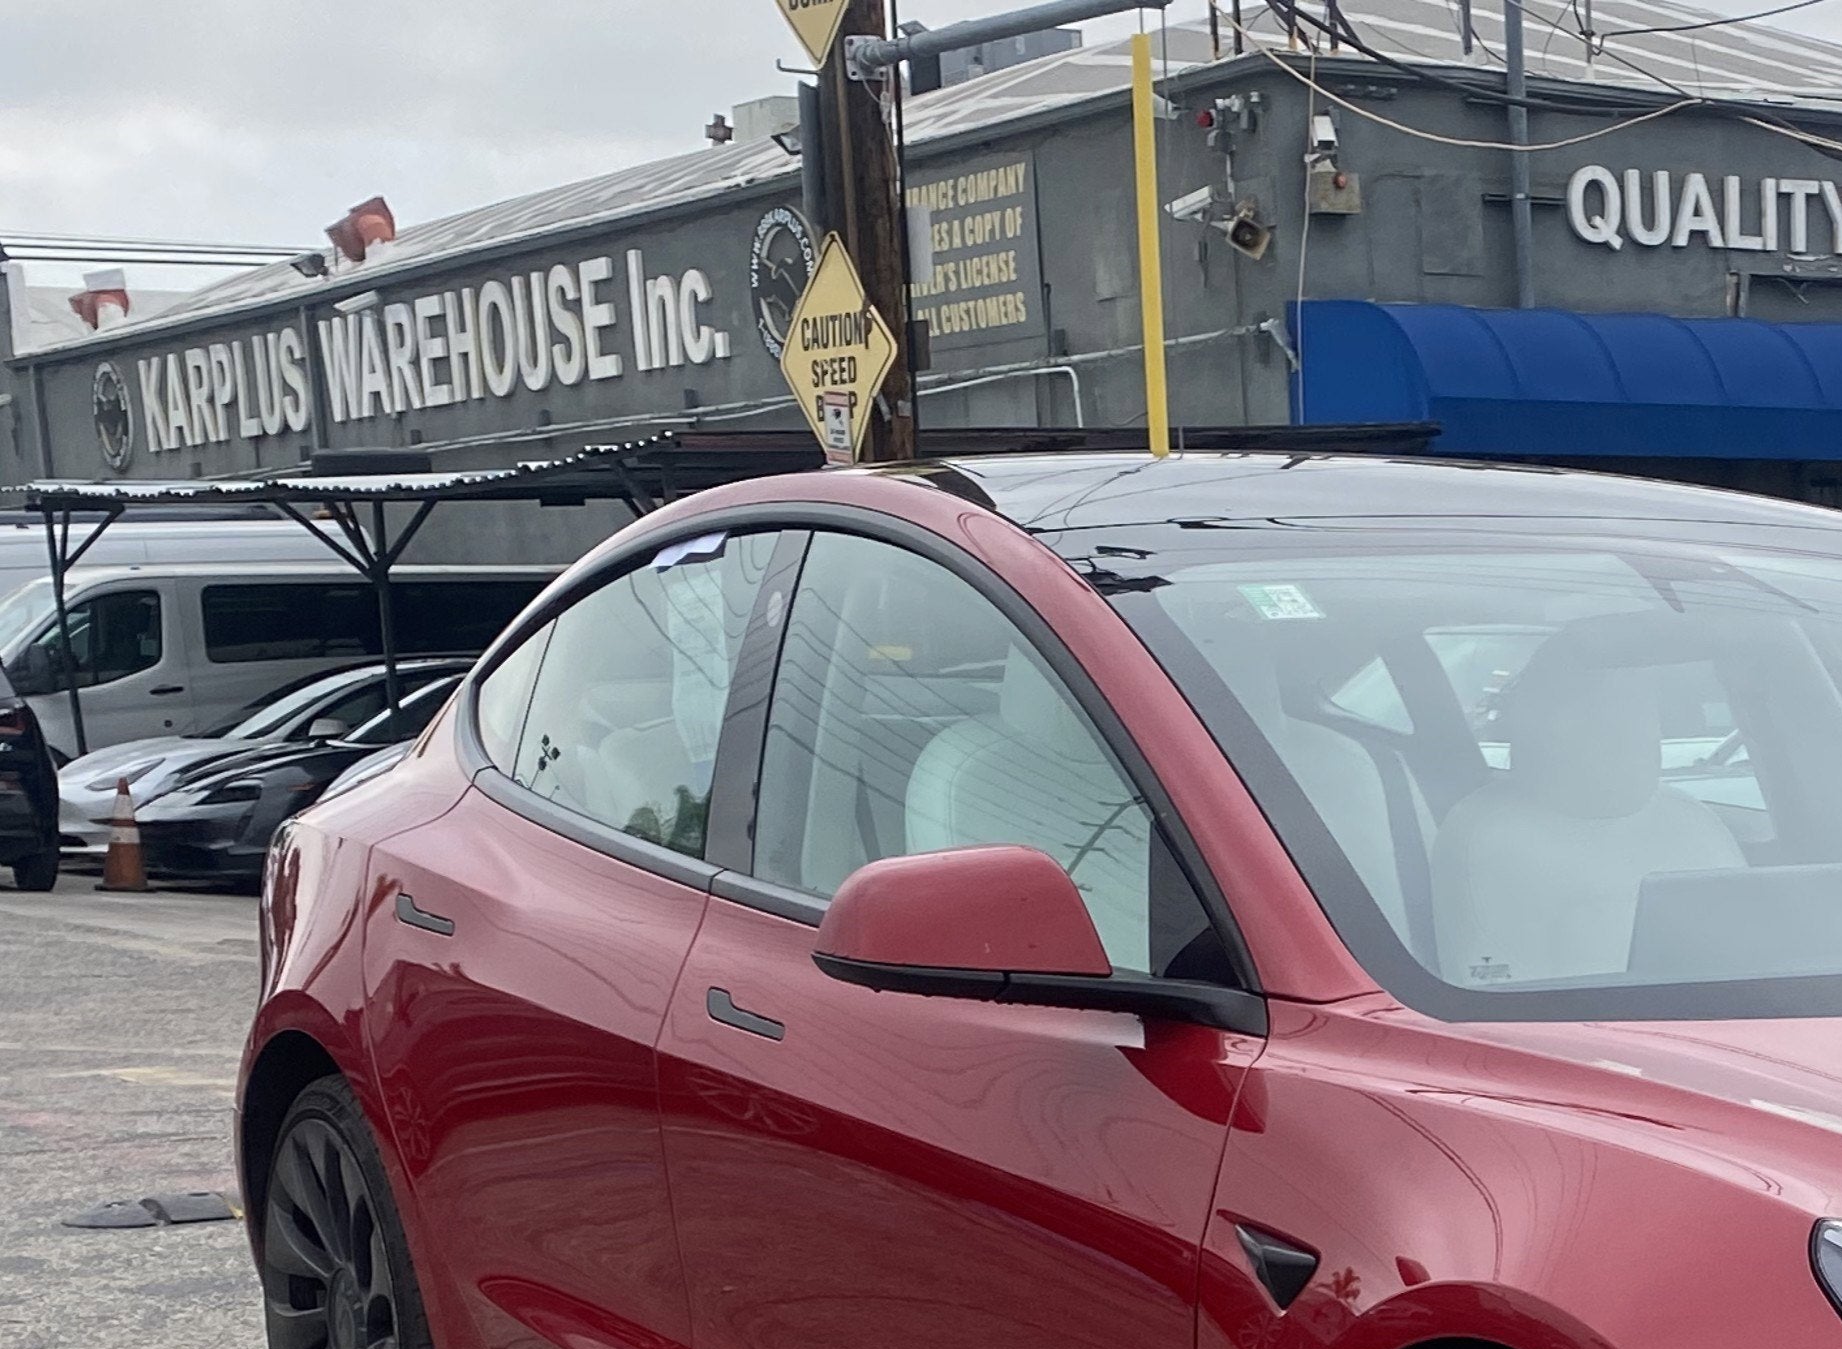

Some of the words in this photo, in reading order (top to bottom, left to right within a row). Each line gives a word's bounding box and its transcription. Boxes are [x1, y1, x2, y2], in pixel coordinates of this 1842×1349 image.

[957, 162, 1026, 206] COMPANY
[952, 219, 962, 249] A
[964, 210, 1001, 247] COPY
[1005, 206, 1022, 239] OF
[959, 249, 1017, 289] LICENSE
[940, 291, 1026, 334] CUSTOMERS
[138, 326, 310, 452] KARPLUS
[317, 256, 623, 423] WAREHOUSE
[626, 249, 731, 372] Inc.
[812, 356, 857, 388] SPEED
[815, 391, 858, 422] BP
